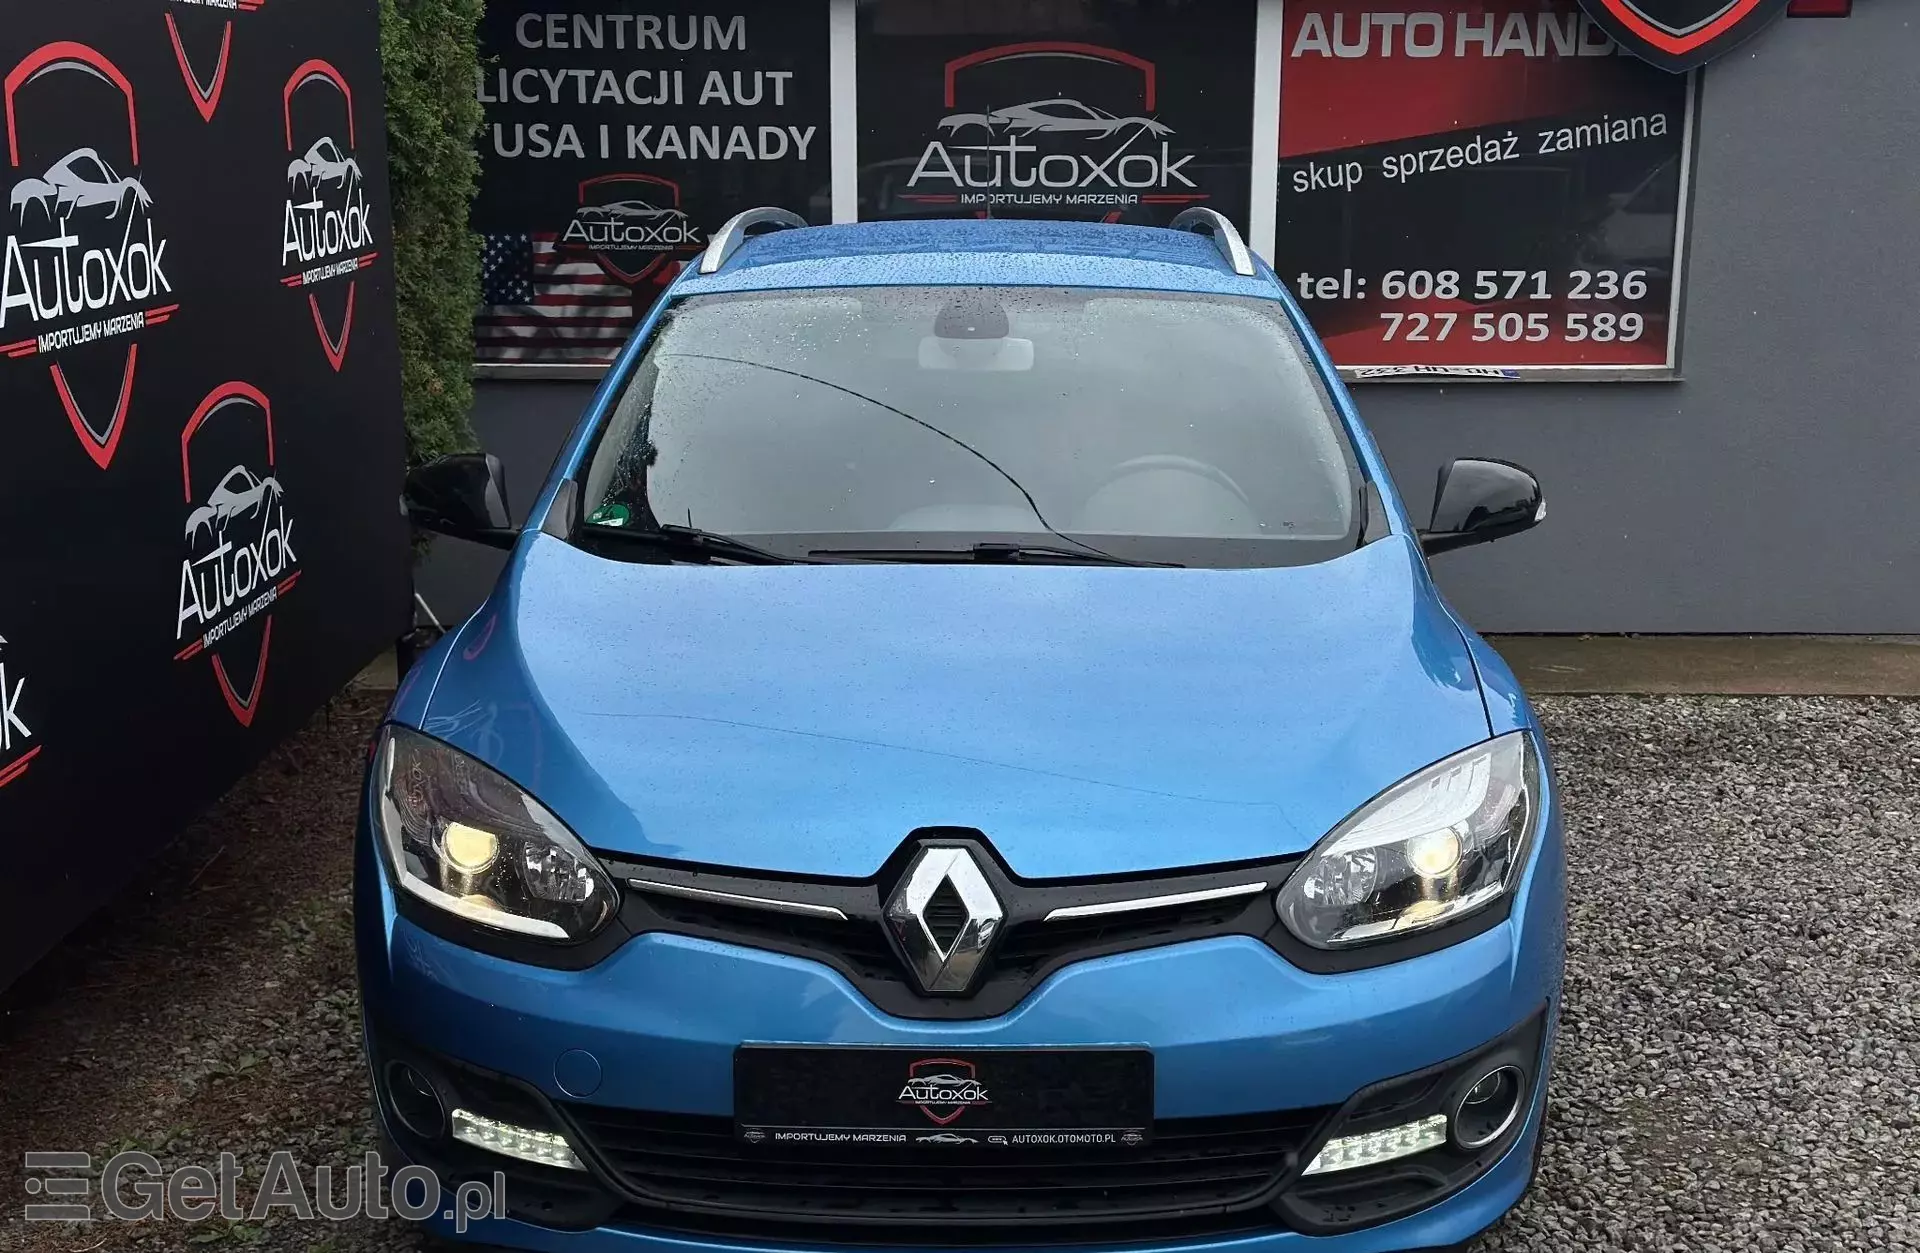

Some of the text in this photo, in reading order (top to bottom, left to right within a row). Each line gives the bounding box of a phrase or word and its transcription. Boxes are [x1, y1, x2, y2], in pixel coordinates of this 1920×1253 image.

[515, 14, 746, 50] CENTRUM
[1291, 12, 1634, 57] AUTO HAND
[476, 67, 793, 105] LICYTACJI AUT
[493, 123, 816, 160] USA I KANADY
[1293, 113, 1667, 193] skup sprzedaż zamiana
[1066, 194, 1138, 204] MARZENIA
[1297, 269, 1648, 300] tel: 608 571 236
[38, 312, 144, 353] IMPORTUJEMY MARZENIA
[1380, 312, 1644, 342] 727 505 589
[775, 1132, 851, 1141] IMPORTUJEMY
[852, 1134, 907, 1142] MARZENIA
[1012, 1134, 1116, 1143] AUTOXOK.OTOMOTO.PL
